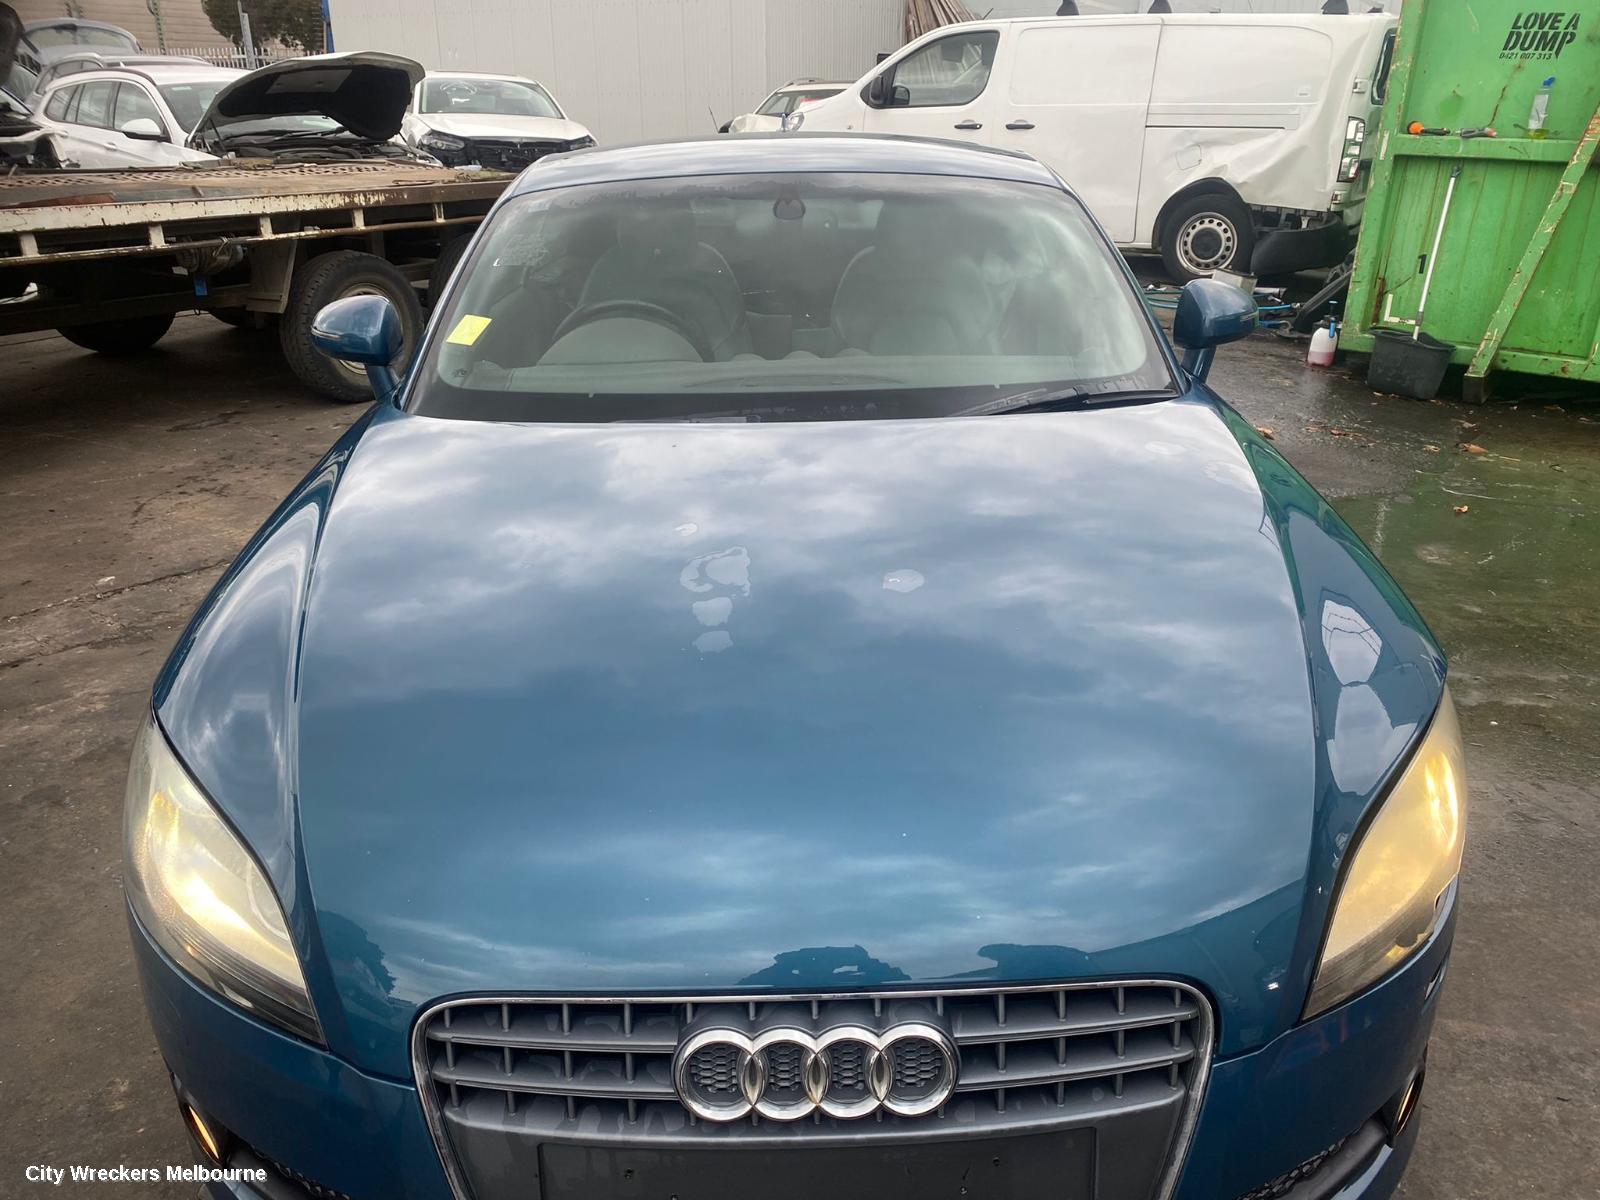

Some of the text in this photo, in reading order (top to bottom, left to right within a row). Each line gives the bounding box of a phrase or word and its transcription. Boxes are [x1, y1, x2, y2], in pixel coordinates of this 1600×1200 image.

[1511, 12, 1581, 30] LOVE A
[1502, 30, 1577, 59] DUMP
[1536, 52, 1553, 60] 313
